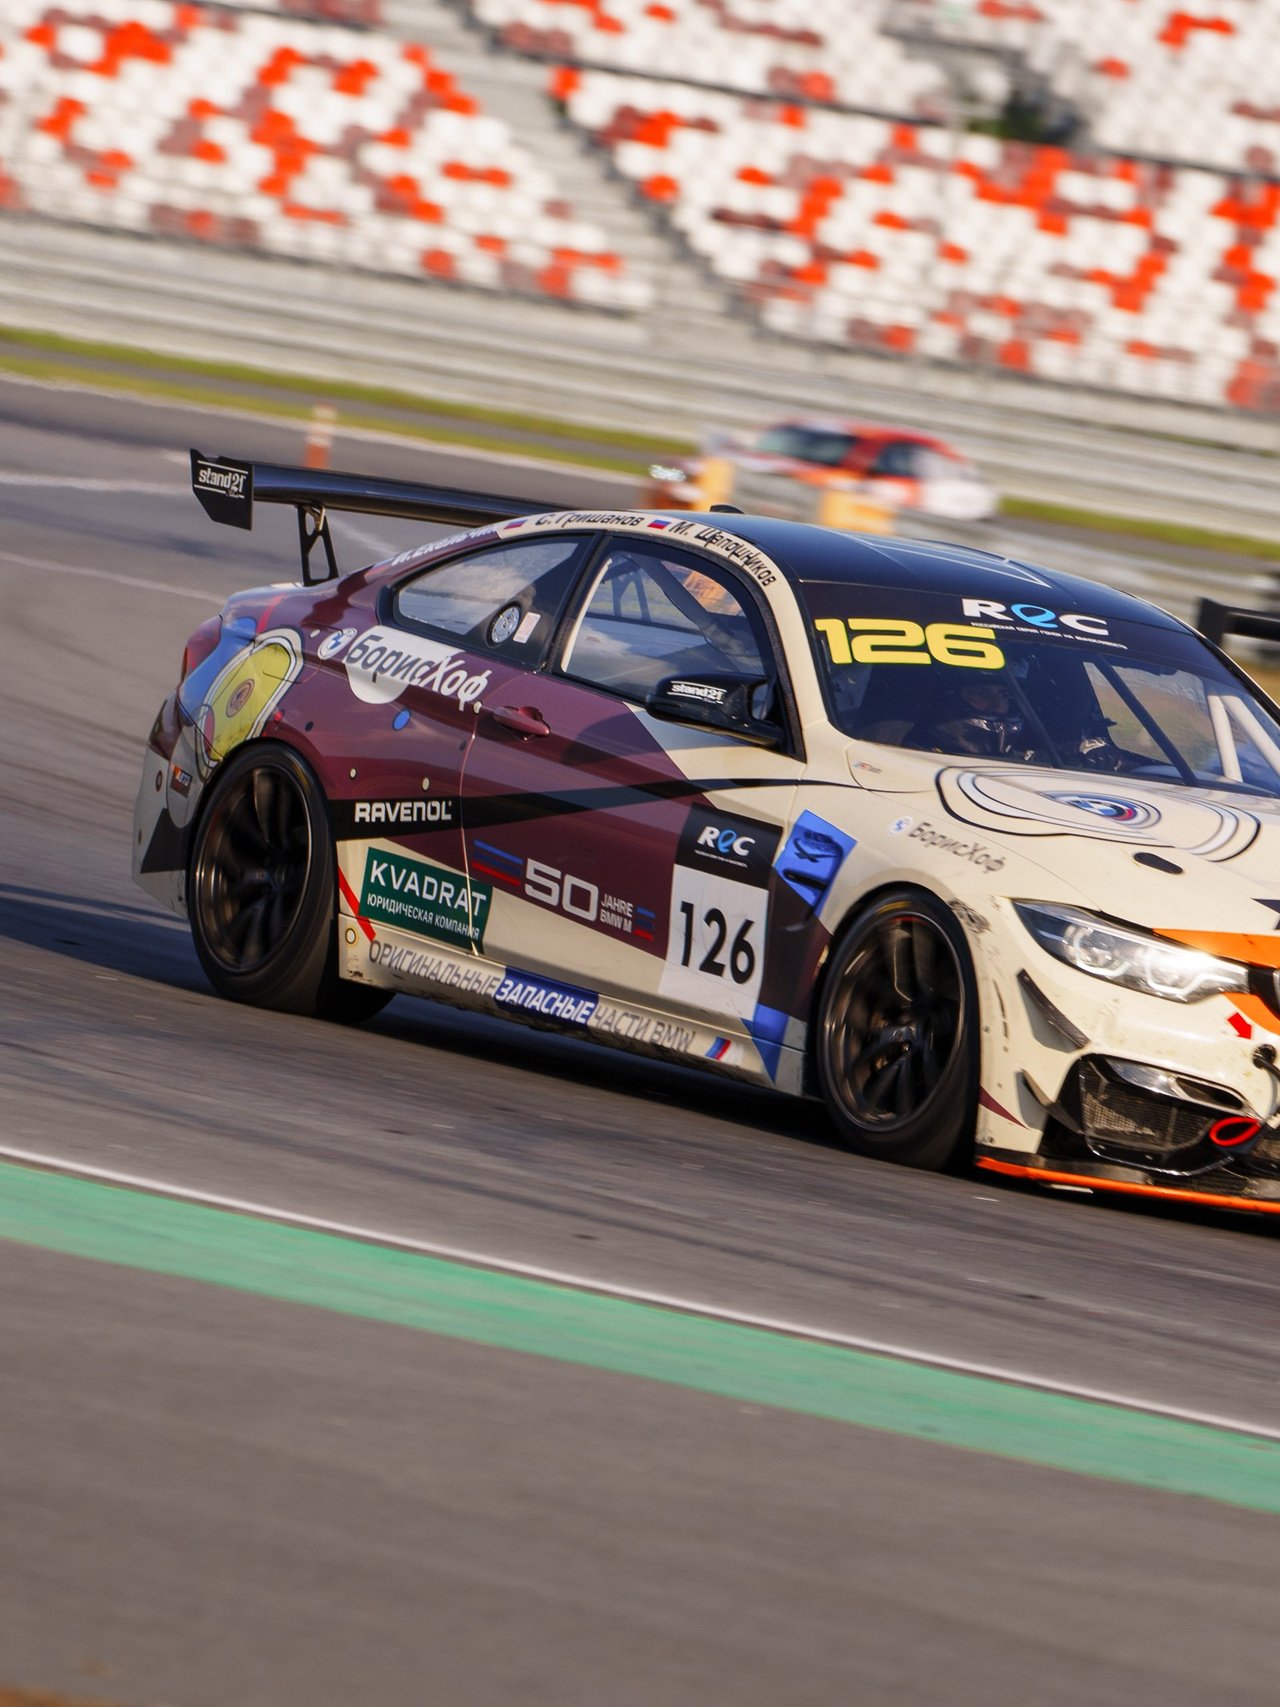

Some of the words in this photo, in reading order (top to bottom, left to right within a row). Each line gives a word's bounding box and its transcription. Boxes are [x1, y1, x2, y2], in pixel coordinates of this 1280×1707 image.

[198, 467, 247, 493] stand21
[556, 511, 645, 528] Гришанов
[668, 520, 695, 536] М.
[814, 618, 1006, 670] 126
[345, 634, 493, 712] БорисХоф
[671, 683, 723, 701] stand21
[355, 800, 453, 823] RAVENOL
[370, 859, 487, 917] KVADRAT
[525, 858, 599, 922] 50
[601, 893, 633, 918] JAHRE
[367, 892, 433, 924] ЮРИДИЧЕСКАЯ
[434, 914, 480, 940] КОМПАНИЯ
[600, 908, 623, 932] BMW
[622, 919, 633, 934] M
[680, 900, 755, 985] 126
[369, 940, 501, 998] ОРИГИНАЛЬНЫЕ
[496, 979, 595, 1025] ЗАПАСНЫЕ
[593, 1004, 650, 1044] ЧАСТИ
[651, 1020, 696, 1053] BMW
